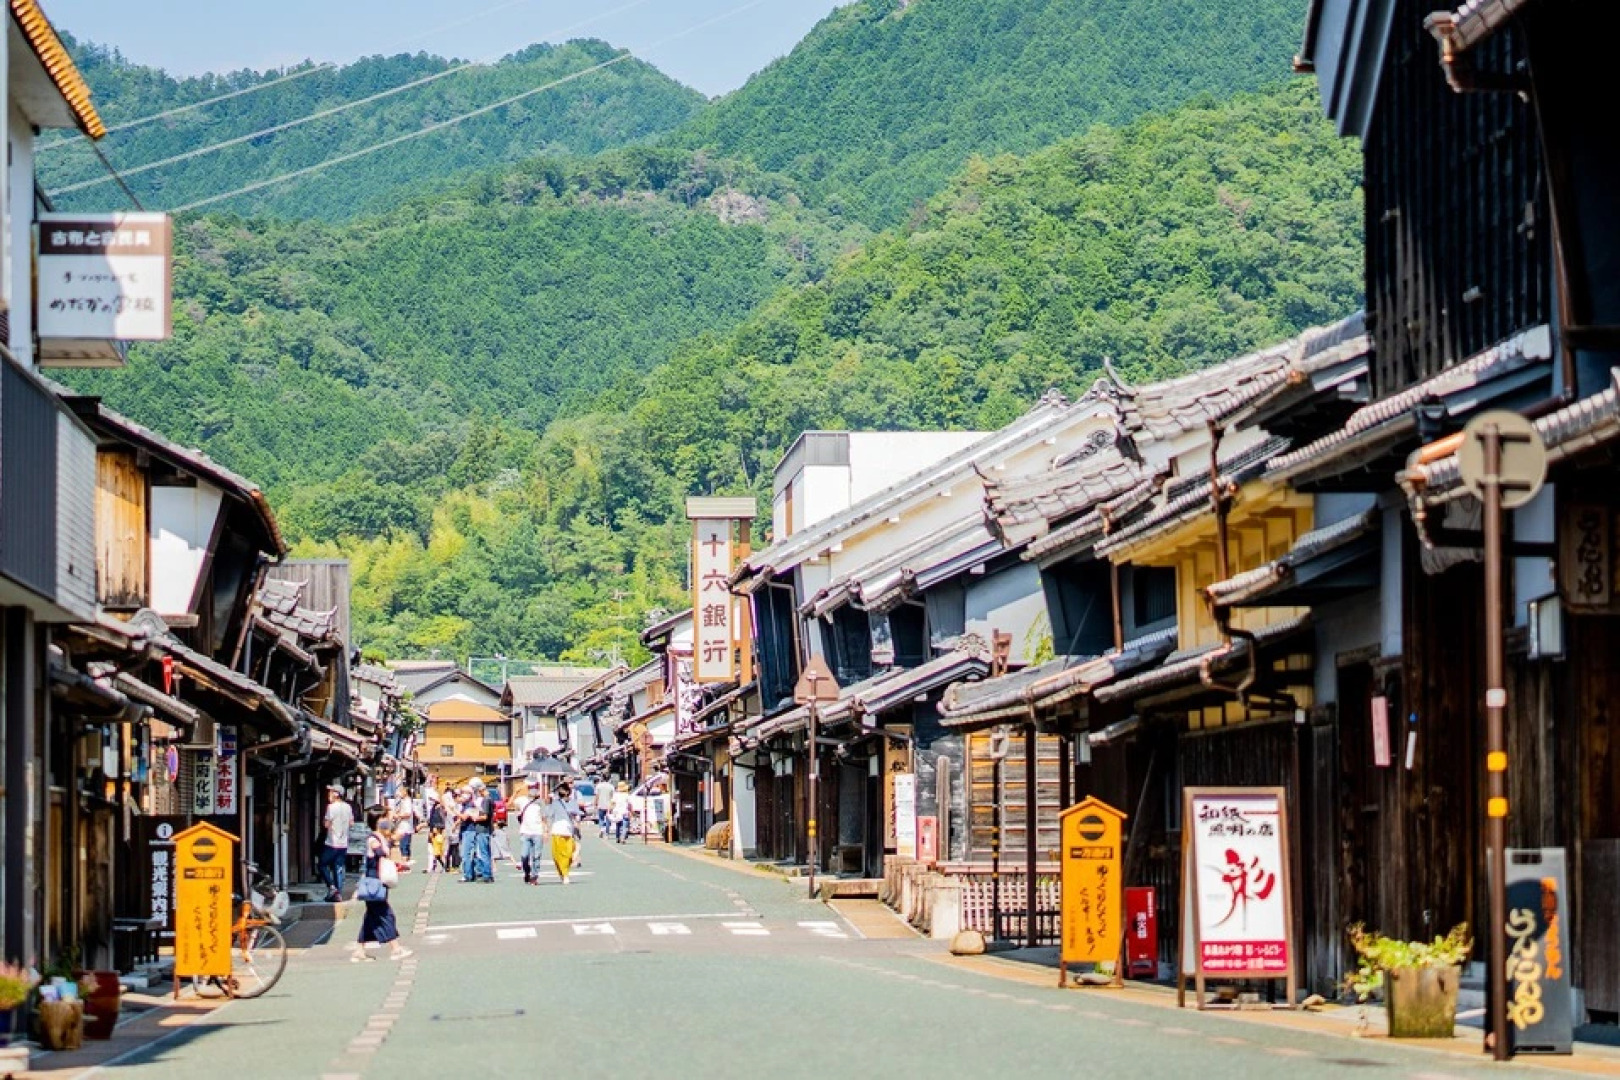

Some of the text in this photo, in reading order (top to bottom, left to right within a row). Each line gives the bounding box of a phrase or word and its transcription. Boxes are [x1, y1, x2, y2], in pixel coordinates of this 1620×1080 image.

[702, 533, 728, 663] 十六銀行
[1210, 848, 1276, 928] 彩
